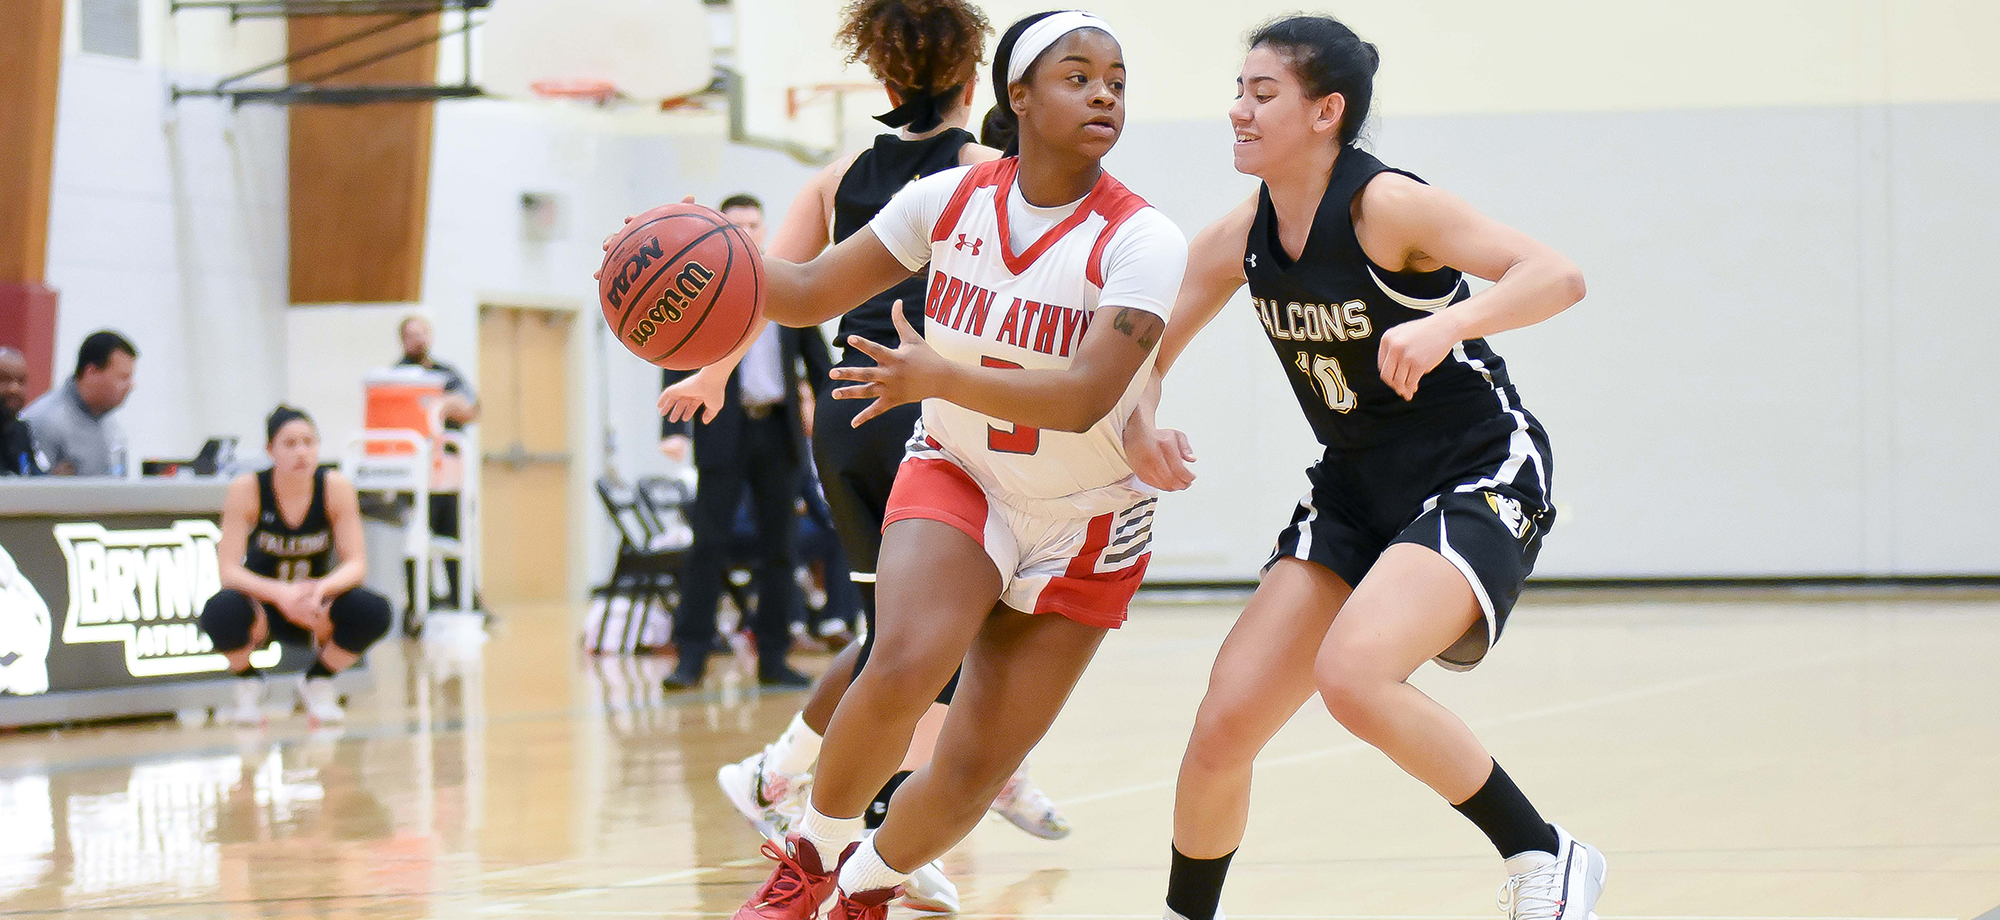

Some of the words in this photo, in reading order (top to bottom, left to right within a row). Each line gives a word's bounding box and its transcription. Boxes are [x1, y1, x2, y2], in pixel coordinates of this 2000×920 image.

[607, 236, 664, 310] NCAA
[626, 260, 716, 348] Wilson
[925, 270, 998, 338] BRYN
[1295, 351, 1358, 414] 10
[75, 541, 191, 623] BRYN
